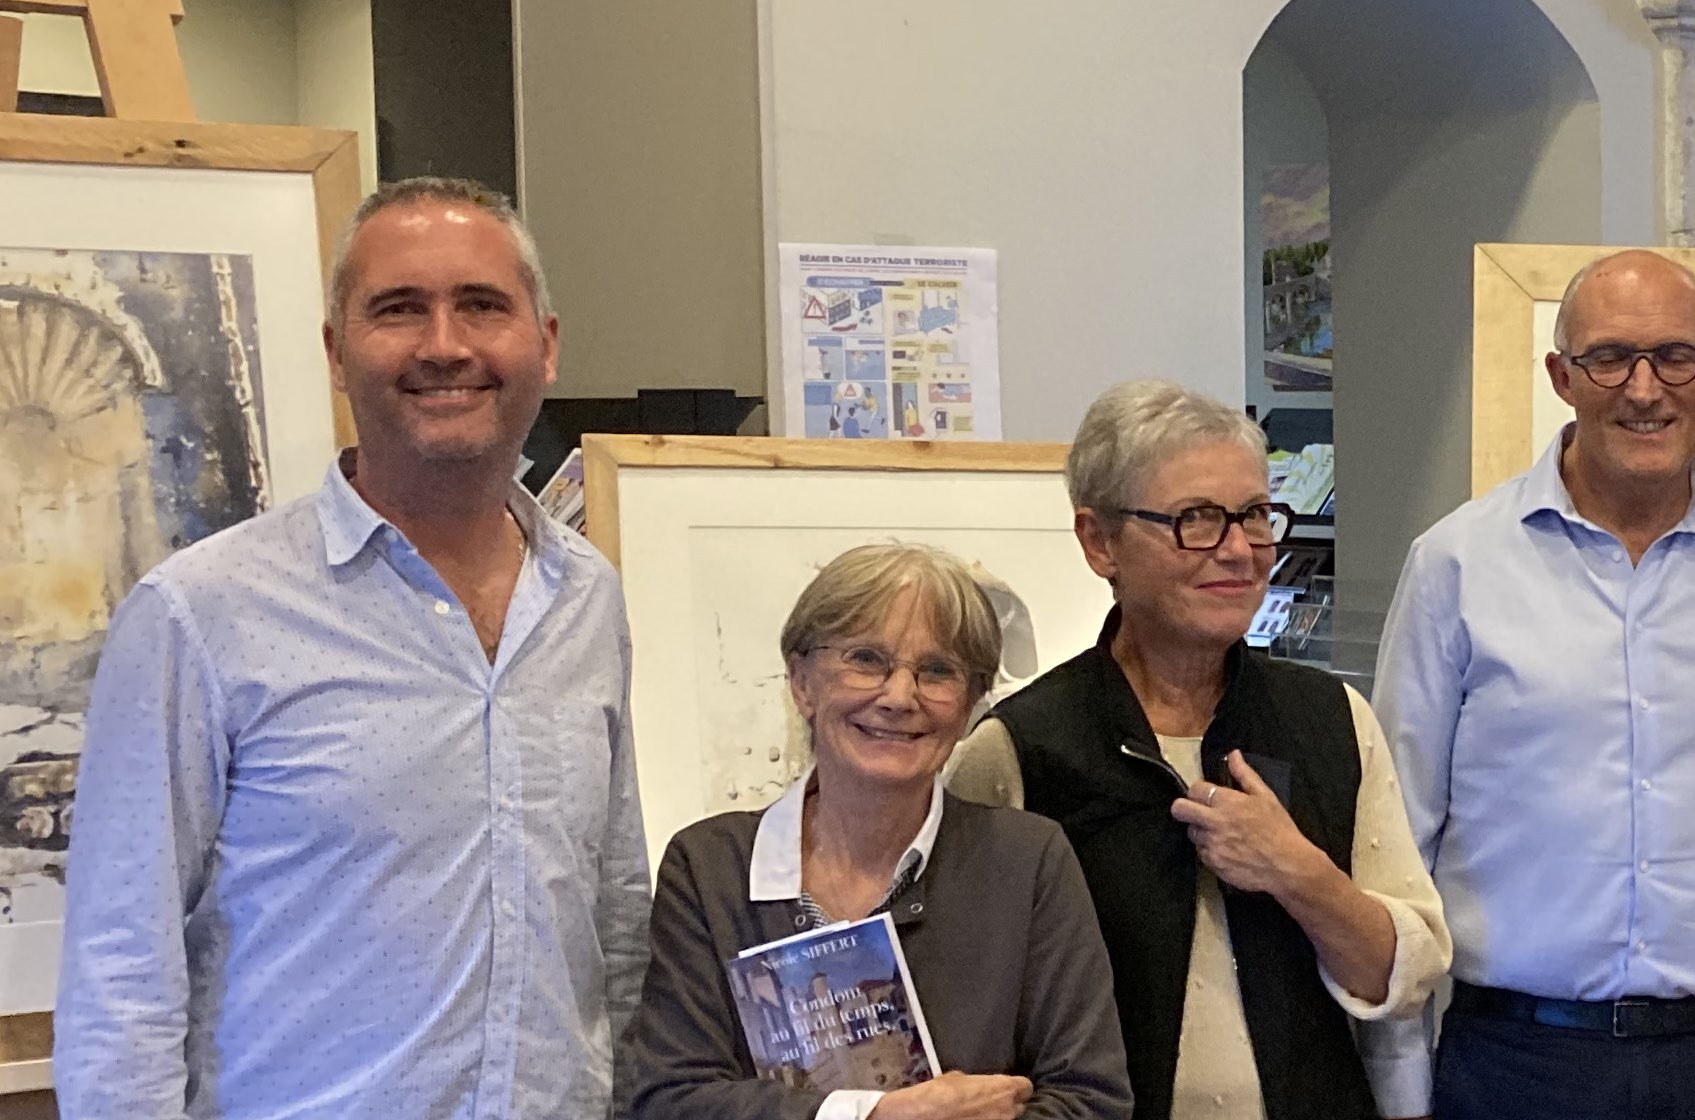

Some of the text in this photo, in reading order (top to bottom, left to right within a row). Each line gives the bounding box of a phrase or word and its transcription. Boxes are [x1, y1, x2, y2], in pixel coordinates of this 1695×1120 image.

[832, 255, 844, 263] EN
[845, 255, 862, 264] CAS
[863, 256, 911, 265] D'ATTAQUE
[913, 257, 968, 267] TERRORISTE
[800, 934, 858, 959] SIFFERT
[769, 1000, 895, 1044] au fil du temps,
[781, 1047, 800, 1062] au
[801, 1036, 820, 1056] fil
[824, 1030, 854, 1050] des
